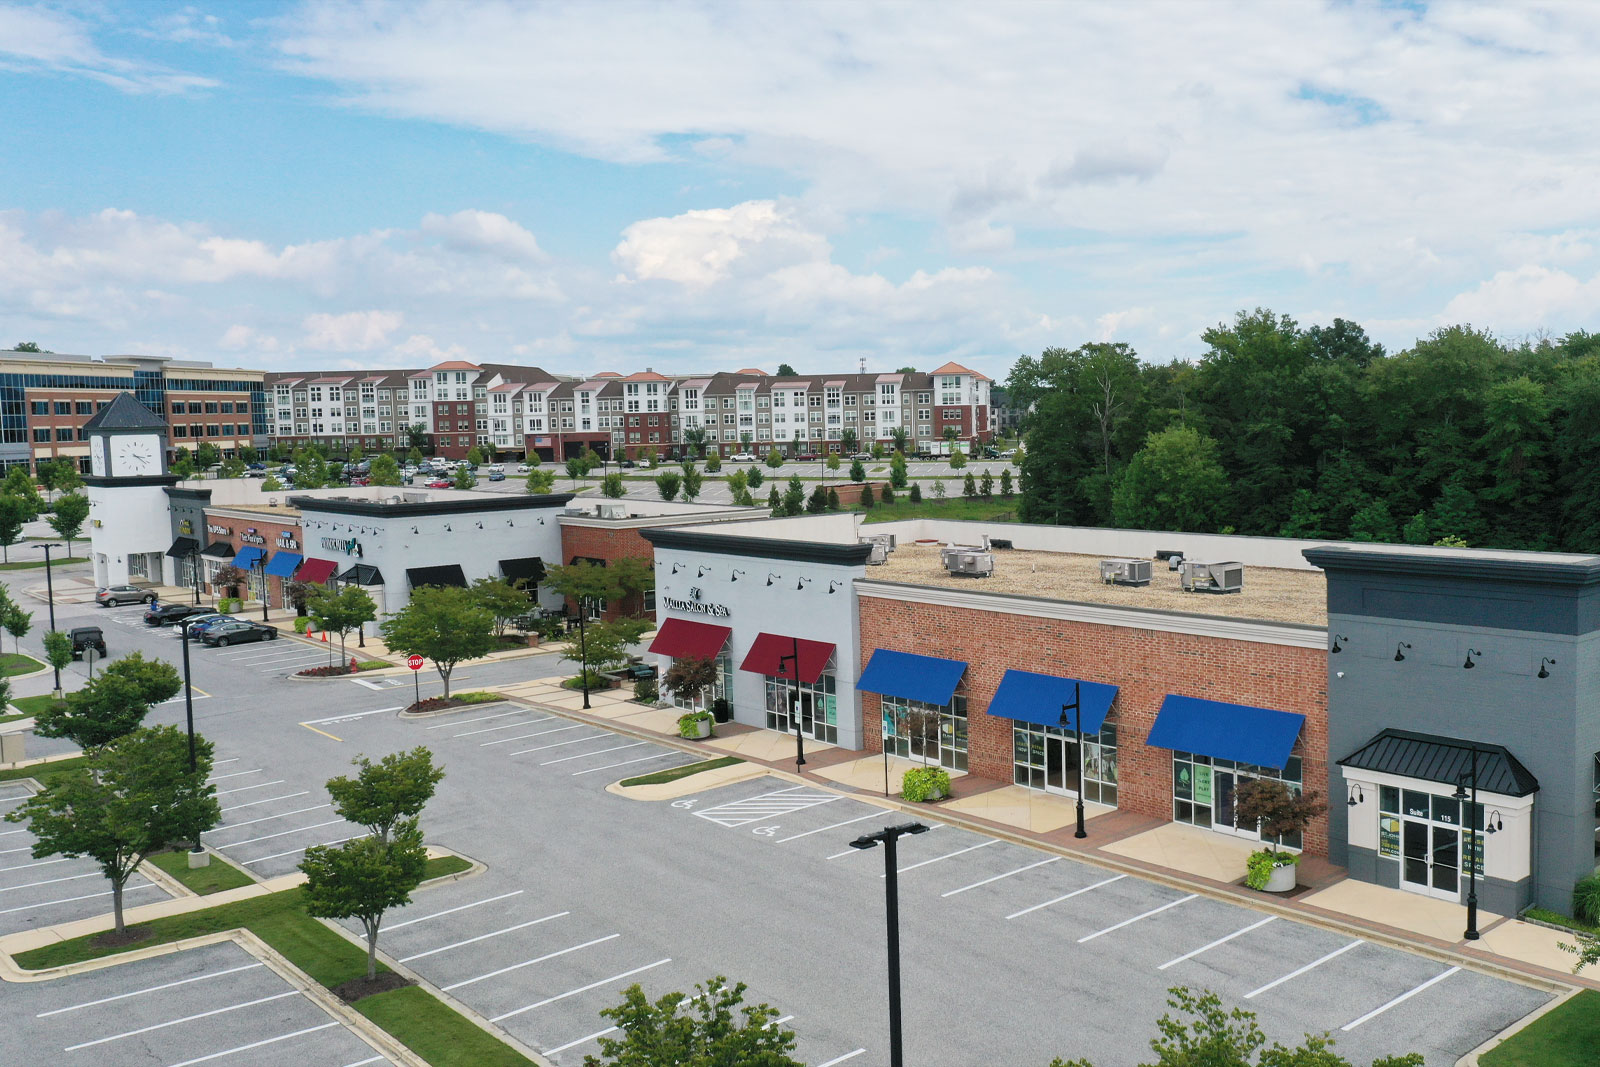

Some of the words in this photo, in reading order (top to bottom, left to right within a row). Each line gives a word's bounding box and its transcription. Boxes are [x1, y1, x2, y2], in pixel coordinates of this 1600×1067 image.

[686, 600, 707, 613] SALON
[707, 603, 715, 616] &
[715, 604, 729, 617] SPA
[408, 658, 423, 667] STOP
[1409, 808, 1424, 817] Suite
[1441, 814, 1452, 823] 115
